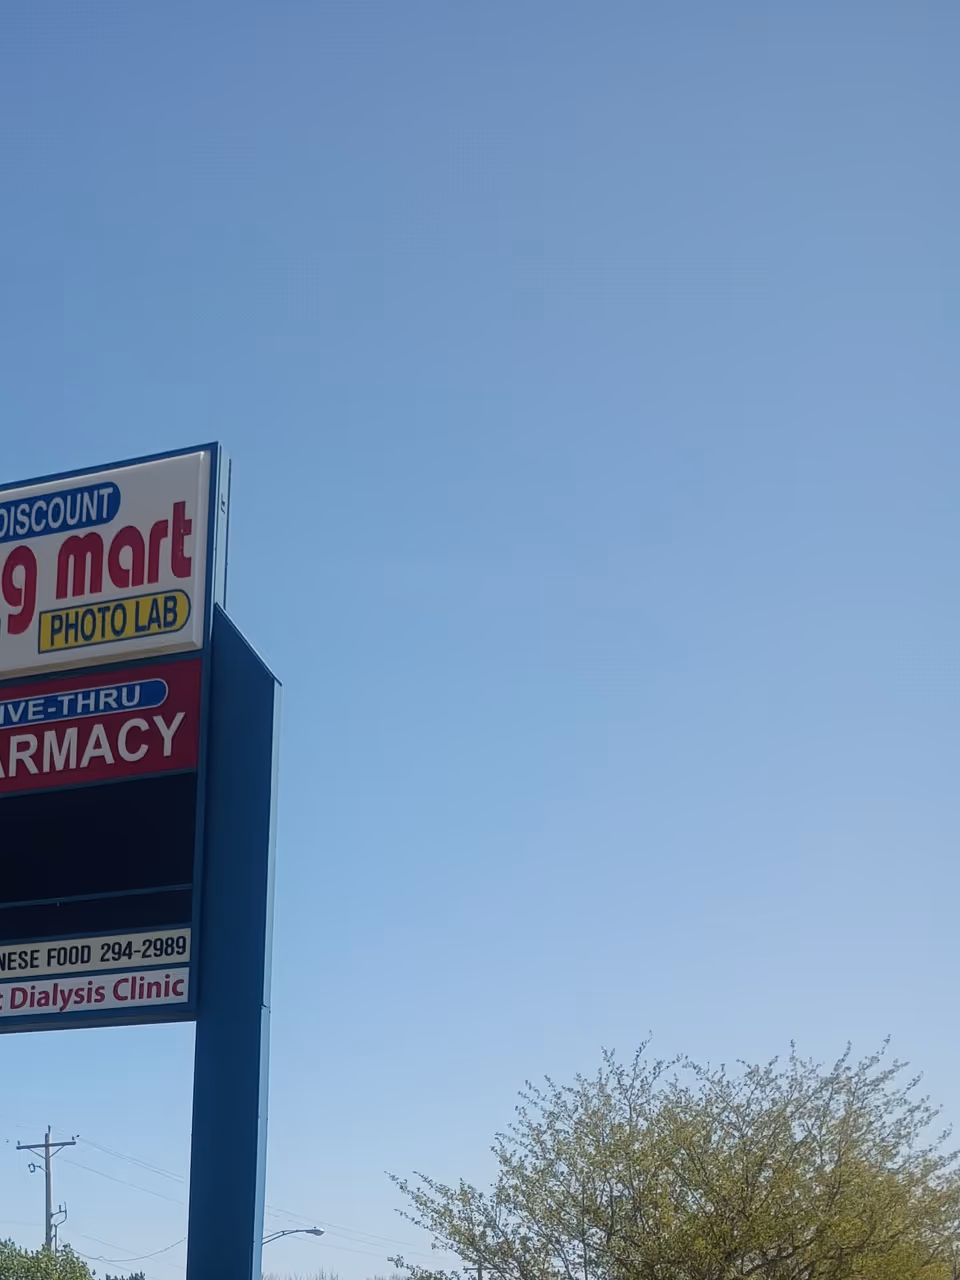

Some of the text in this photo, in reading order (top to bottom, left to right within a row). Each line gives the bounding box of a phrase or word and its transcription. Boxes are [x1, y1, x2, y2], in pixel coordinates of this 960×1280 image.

[55, 501, 192, 600] mart
[50, 595, 178, 646] PHOTO LAB
[47, 945, 91, 967] FOOD
[100, 935, 187, 962] 294-2989
[9, 980, 106, 1012] Dialysis
[112, 973, 185, 1001] Clinic
